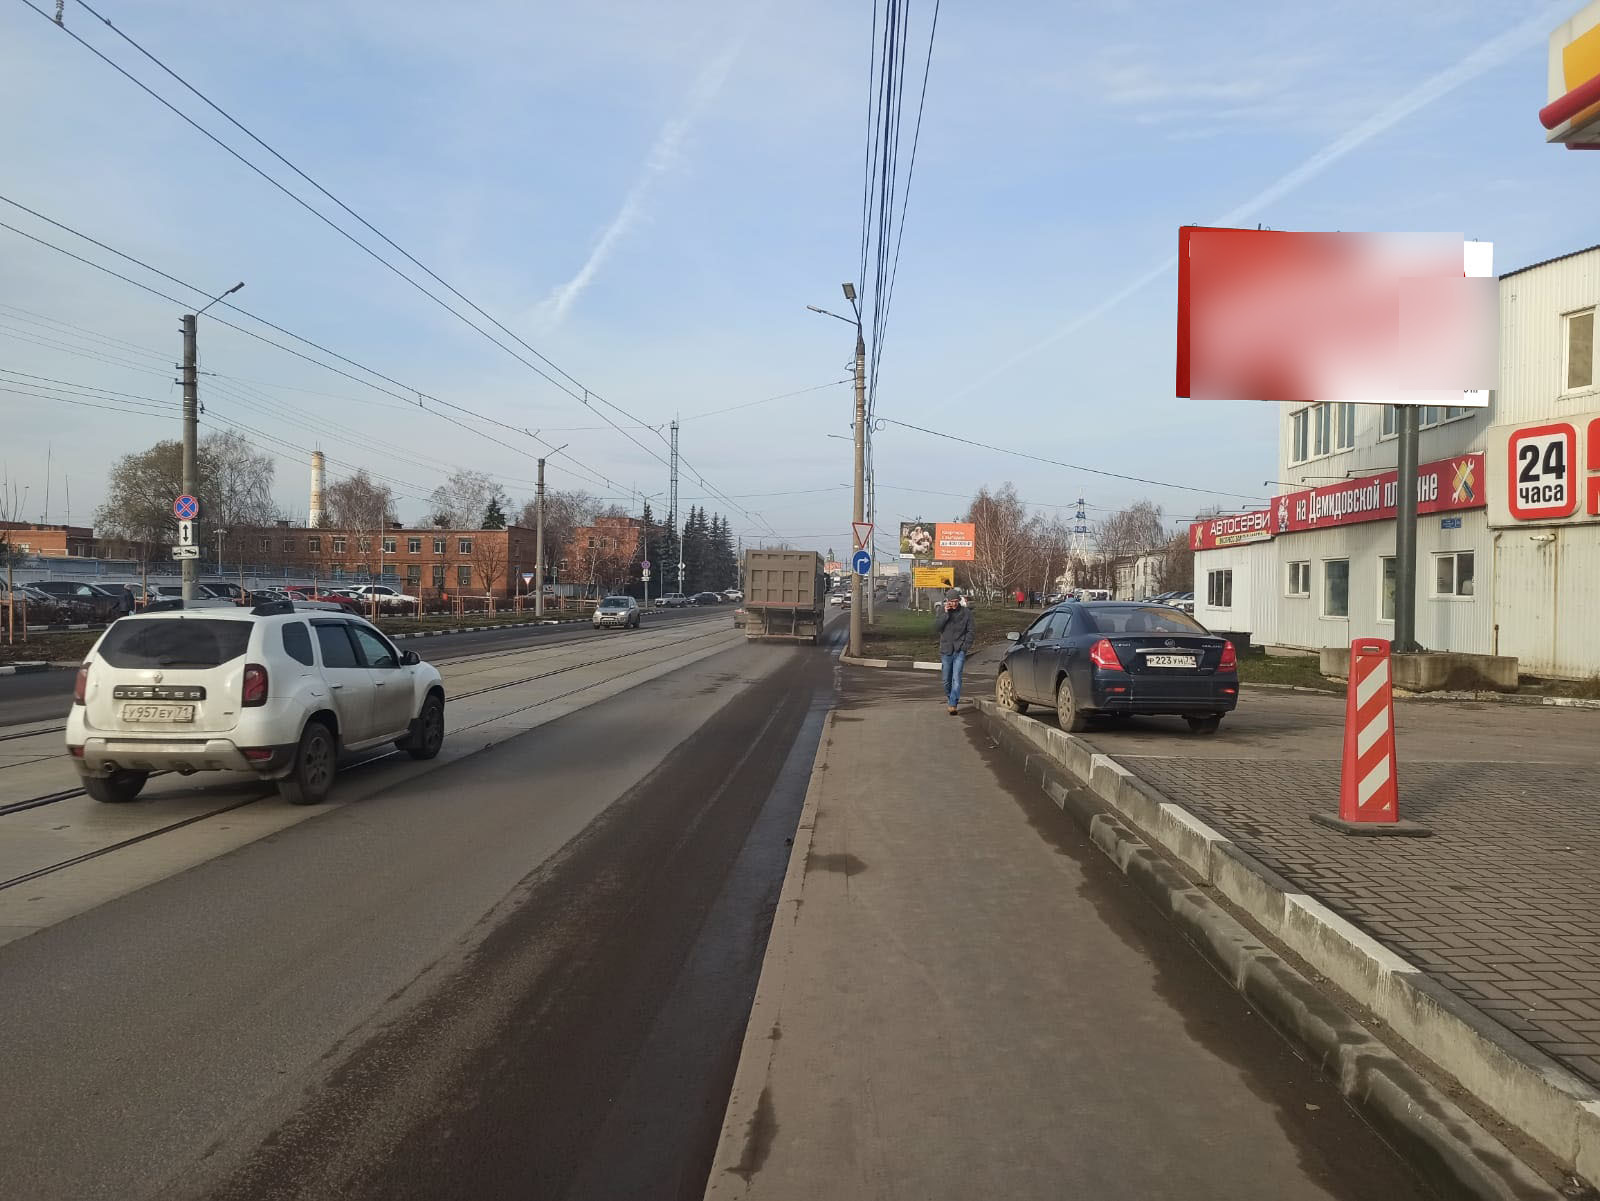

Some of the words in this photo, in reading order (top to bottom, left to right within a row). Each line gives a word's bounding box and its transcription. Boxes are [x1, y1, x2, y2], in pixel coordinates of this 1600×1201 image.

[1519, 441, 1566, 483] 24
[1296, 499, 1306, 521] на
[1309, 480, 1380, 524] Демидовской
[1384, 473, 1438, 507] плине
[1519, 484, 1564, 504] часа
[1211, 512, 1271, 537] АВТОСЕРВИ
[114, 690, 201, 698] DUSTER
